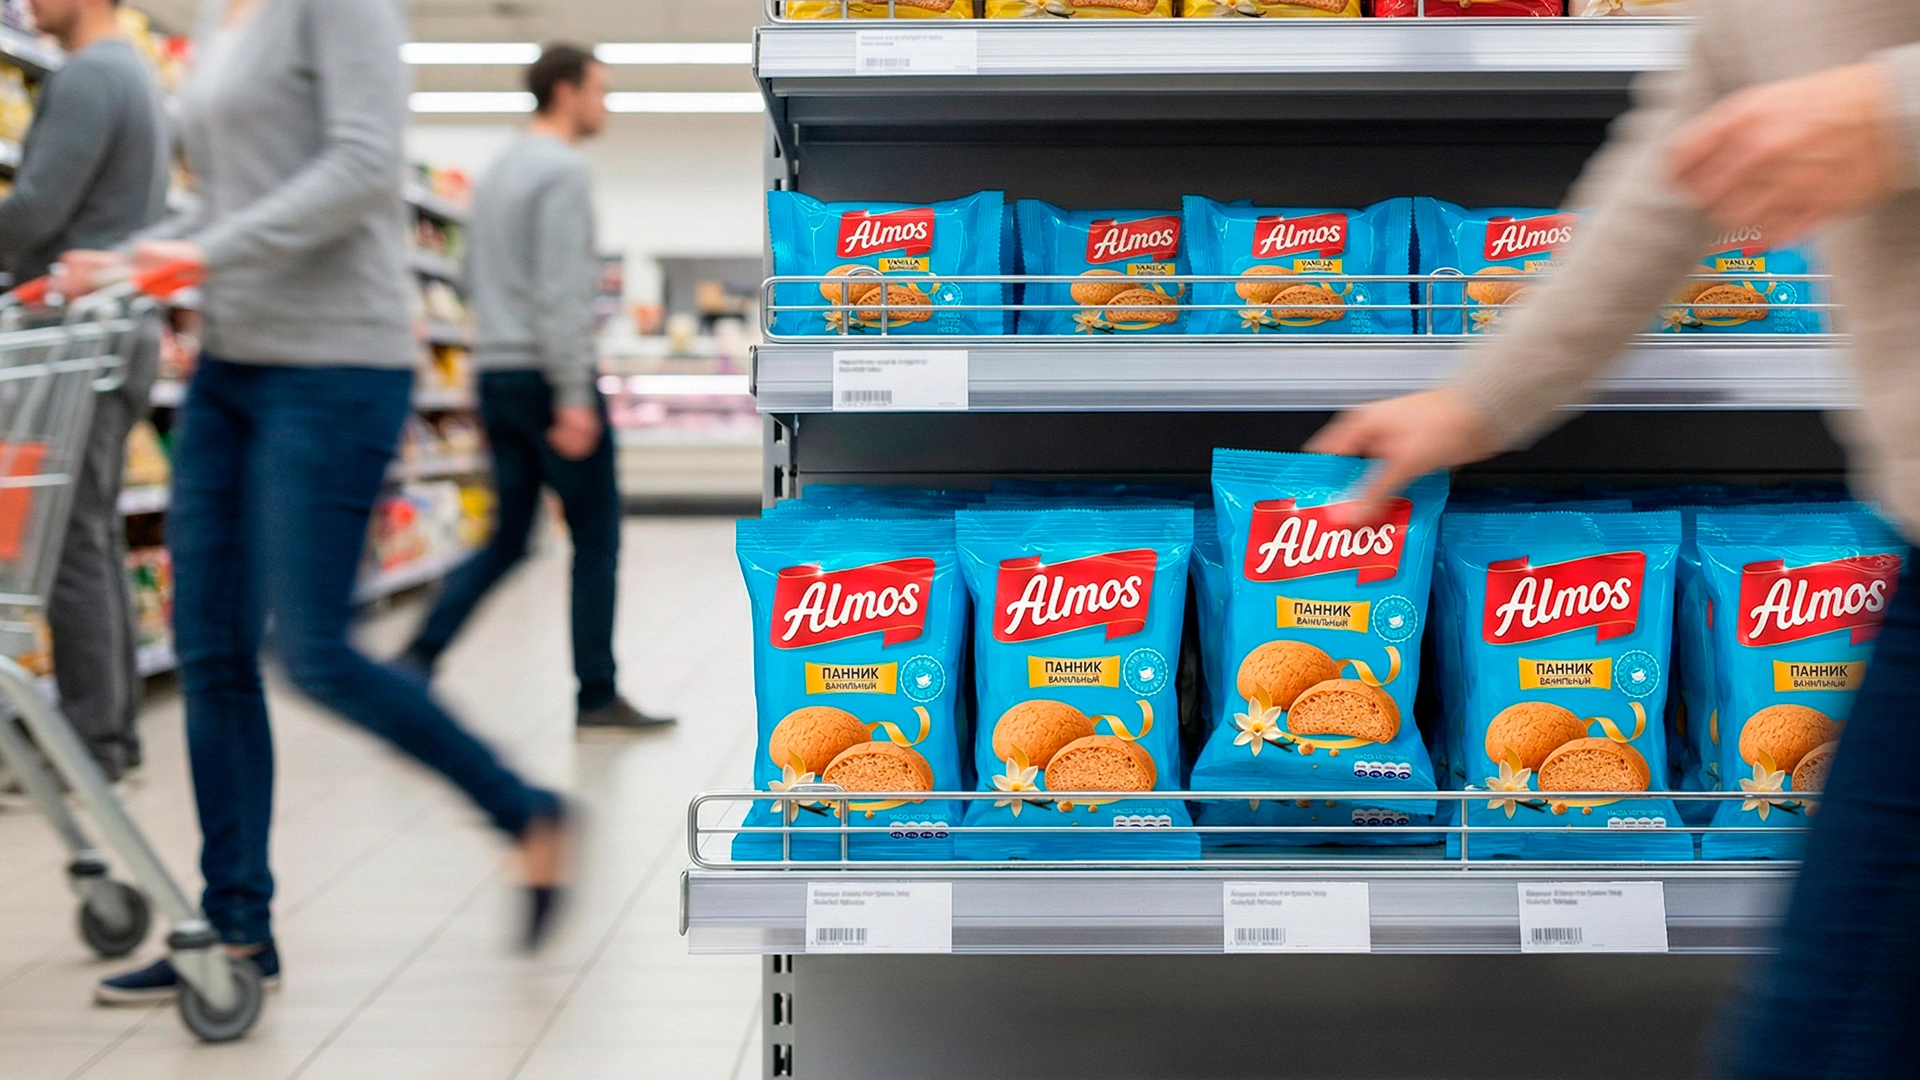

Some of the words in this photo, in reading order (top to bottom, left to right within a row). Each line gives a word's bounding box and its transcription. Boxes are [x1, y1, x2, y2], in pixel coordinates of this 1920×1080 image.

[845, 220, 927, 253] Almos
[1094, 228, 1174, 260] Almos
[1259, 223, 1341, 255] Almos
[1491, 225, 1572, 257] Almos
[1255, 516, 1396, 574] Almos
[781, 581, 920, 641] Almos
[1004, 574, 1142, 635] Almos
[1293, 602, 1352, 617] ПАННИК
[1494, 576, 1632, 637] Almos
[1749, 577, 1887, 639] Almos
[822, 667, 879, 680] ПАННИК
[1045, 661, 1103, 673] ПАННИК
[1536, 663, 1594, 675] ПАННИК
[1790, 665, 1848, 677] ПАННИК
